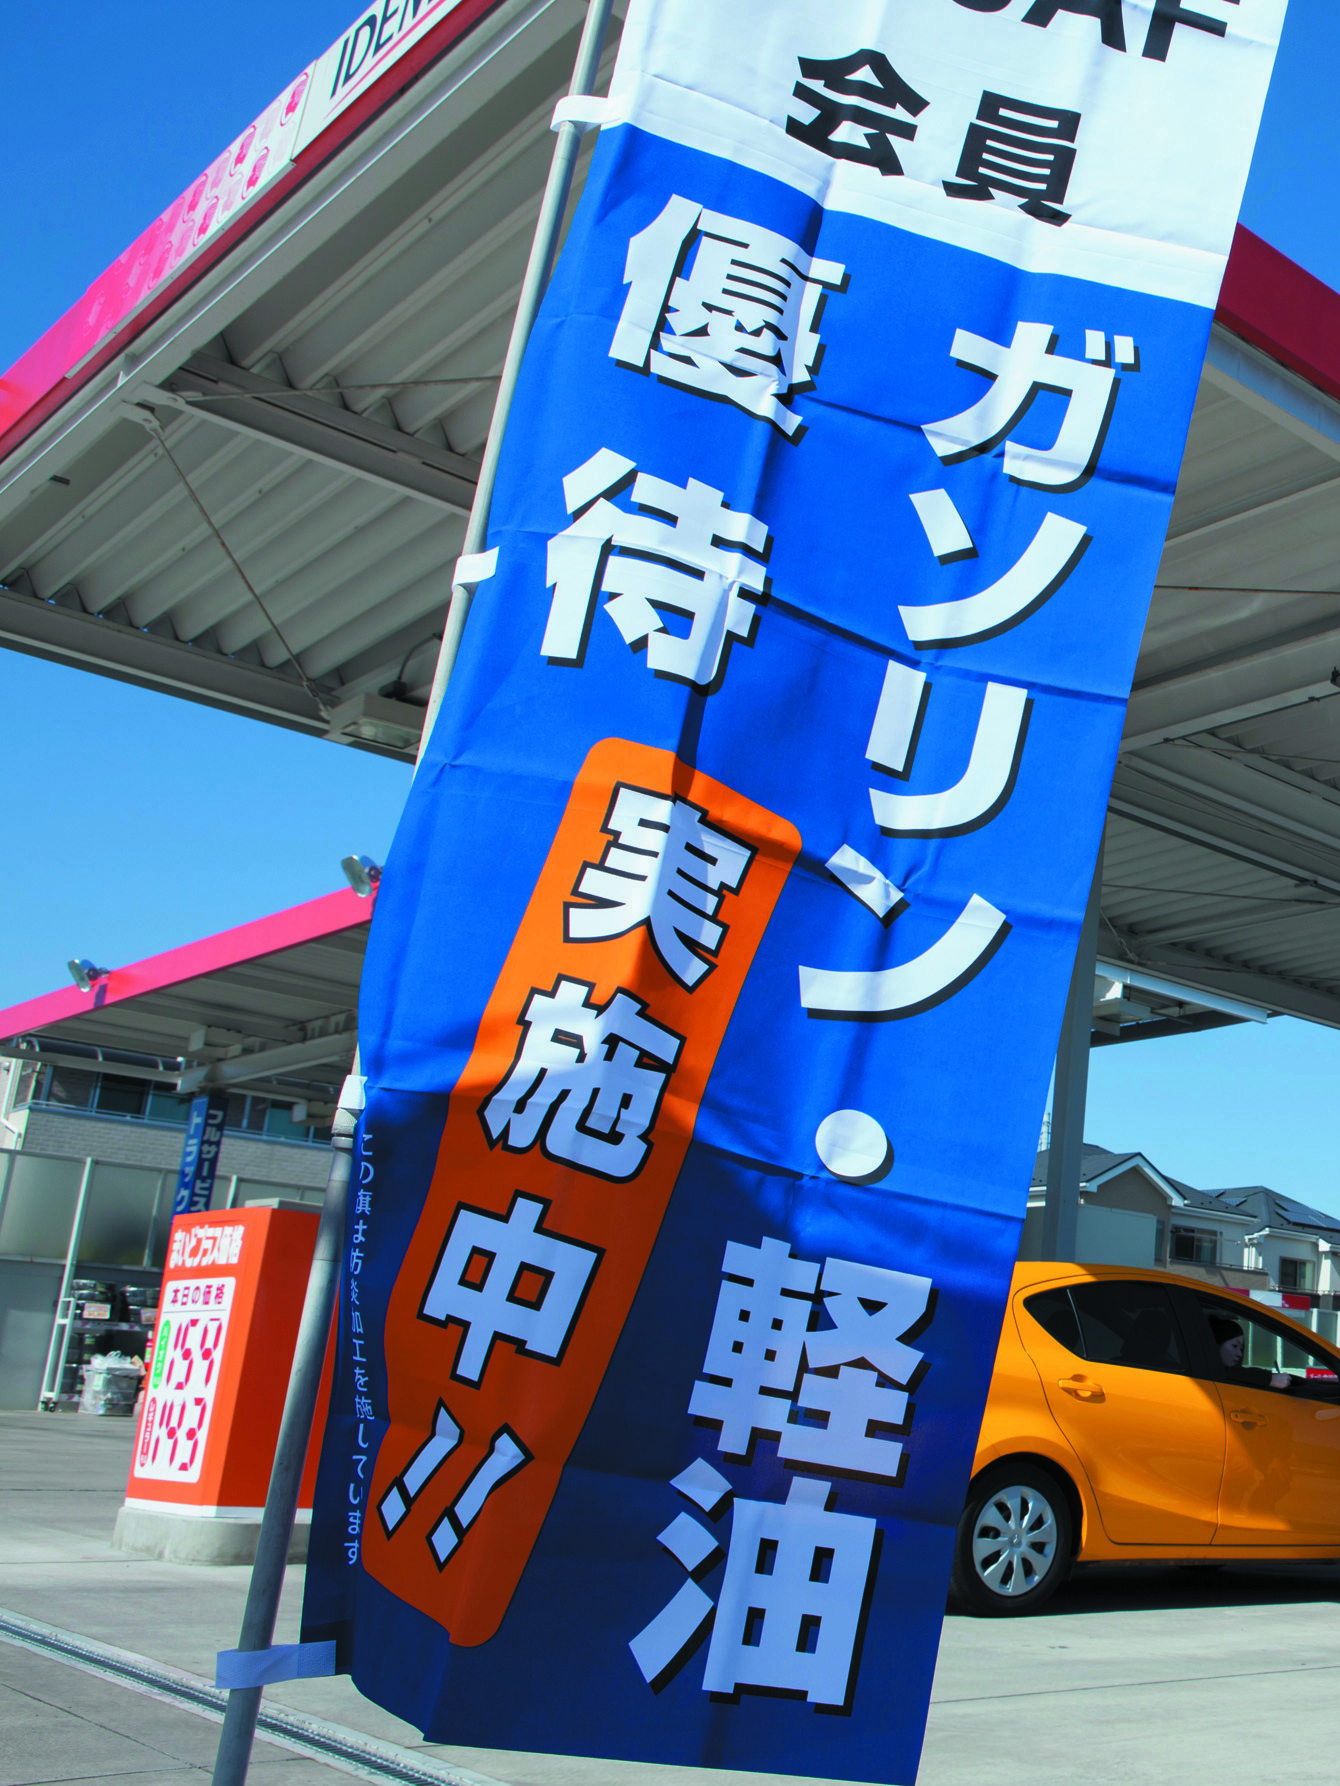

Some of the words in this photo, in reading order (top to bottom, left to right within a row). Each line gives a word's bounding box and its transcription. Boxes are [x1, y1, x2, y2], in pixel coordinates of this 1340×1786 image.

[786, 48, 1082, 227] 会員
[541, 193, 848, 688] 優待
[628, 321, 1138, 1711] ガソリン・軽油
[176, 1110, 203, 1212] トラック
[190, 1109, 224, 1212] フルサービス
[168, 1224, 246, 1270] まいどプラス価格
[170, 1283, 226, 1306] 本日の価格
[151, 1397, 207, 1472] 143
